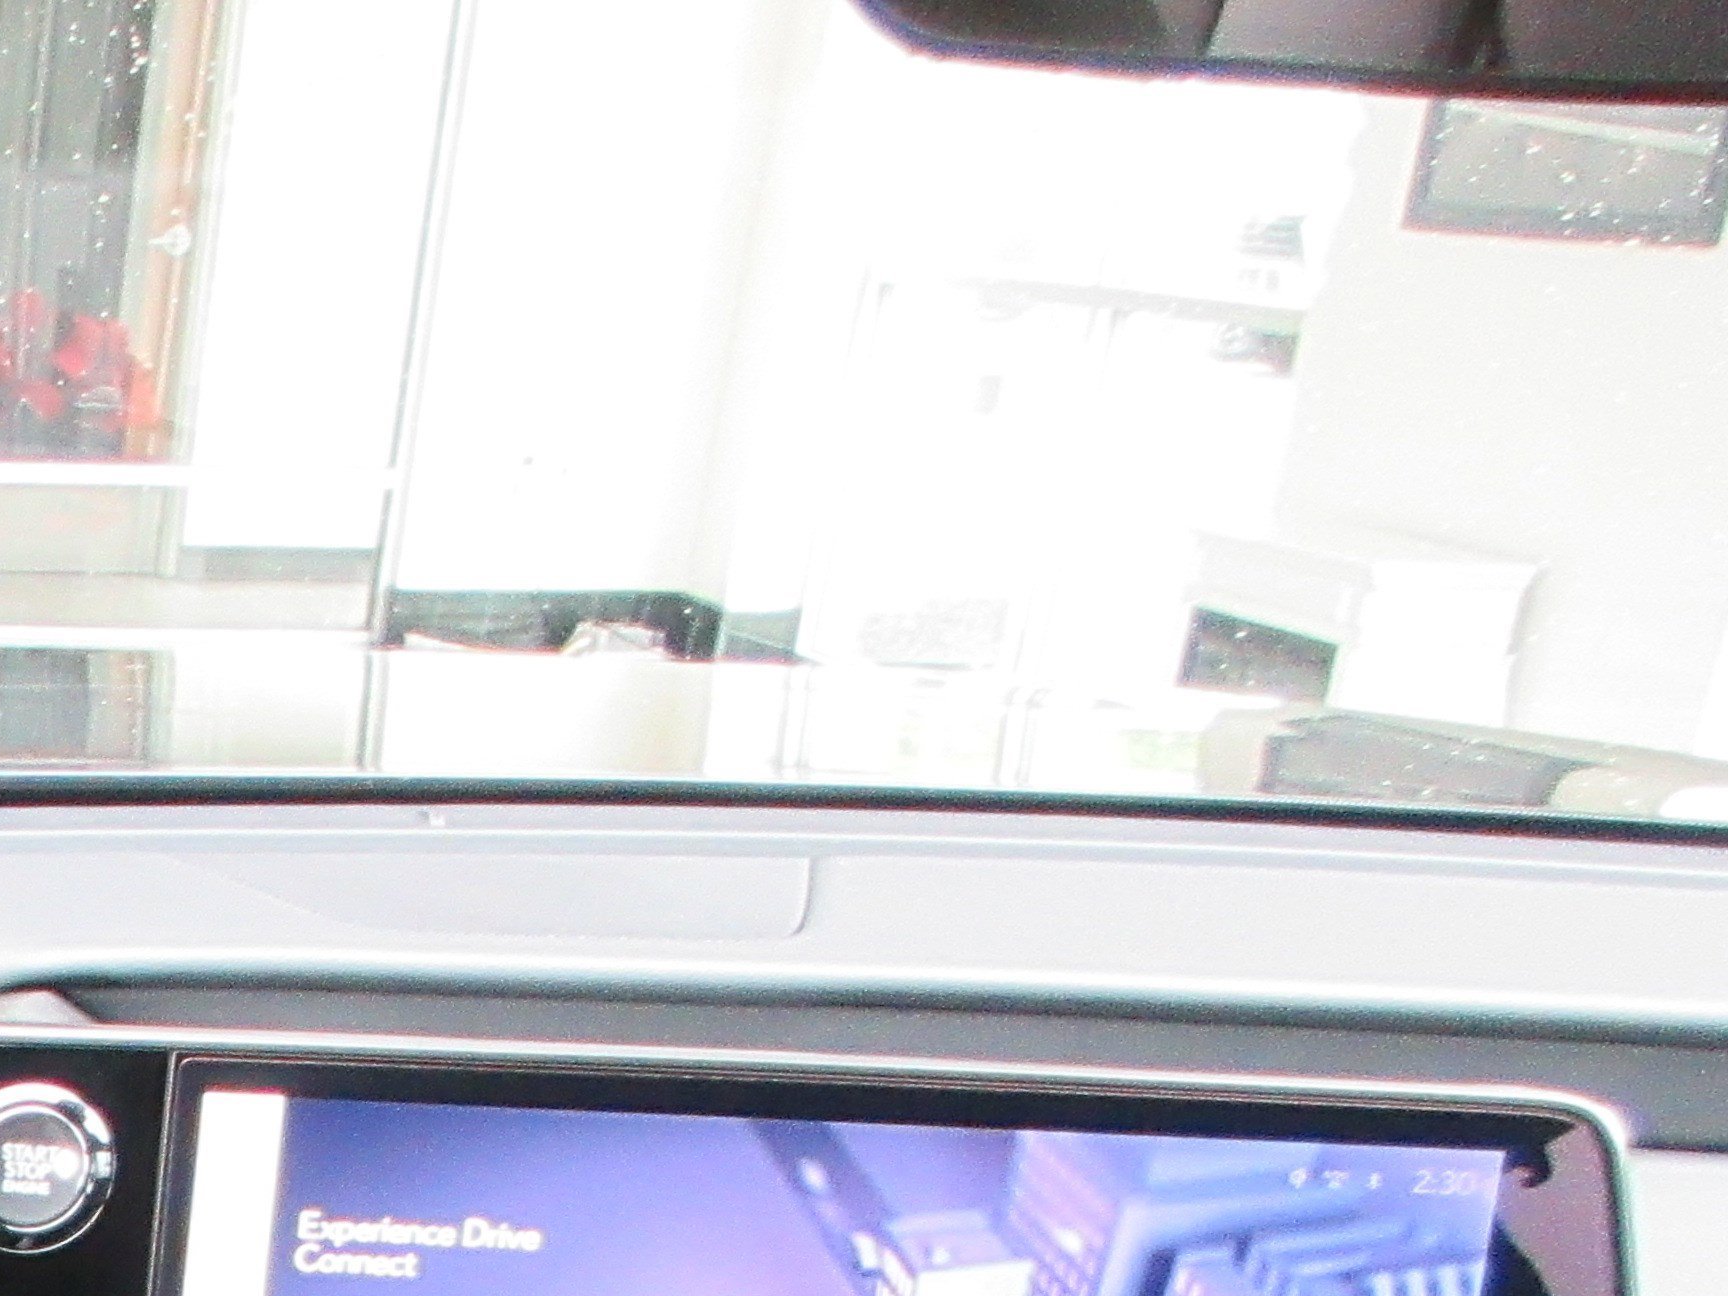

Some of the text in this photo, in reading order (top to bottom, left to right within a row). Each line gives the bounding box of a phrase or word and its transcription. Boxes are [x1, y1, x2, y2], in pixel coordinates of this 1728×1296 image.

[2, 1142, 57, 1162] START
[4, 1160, 52, 1180] STOP
[297, 1208, 542, 1252] Experience Drive
[293, 1242, 420, 1279] Connect
